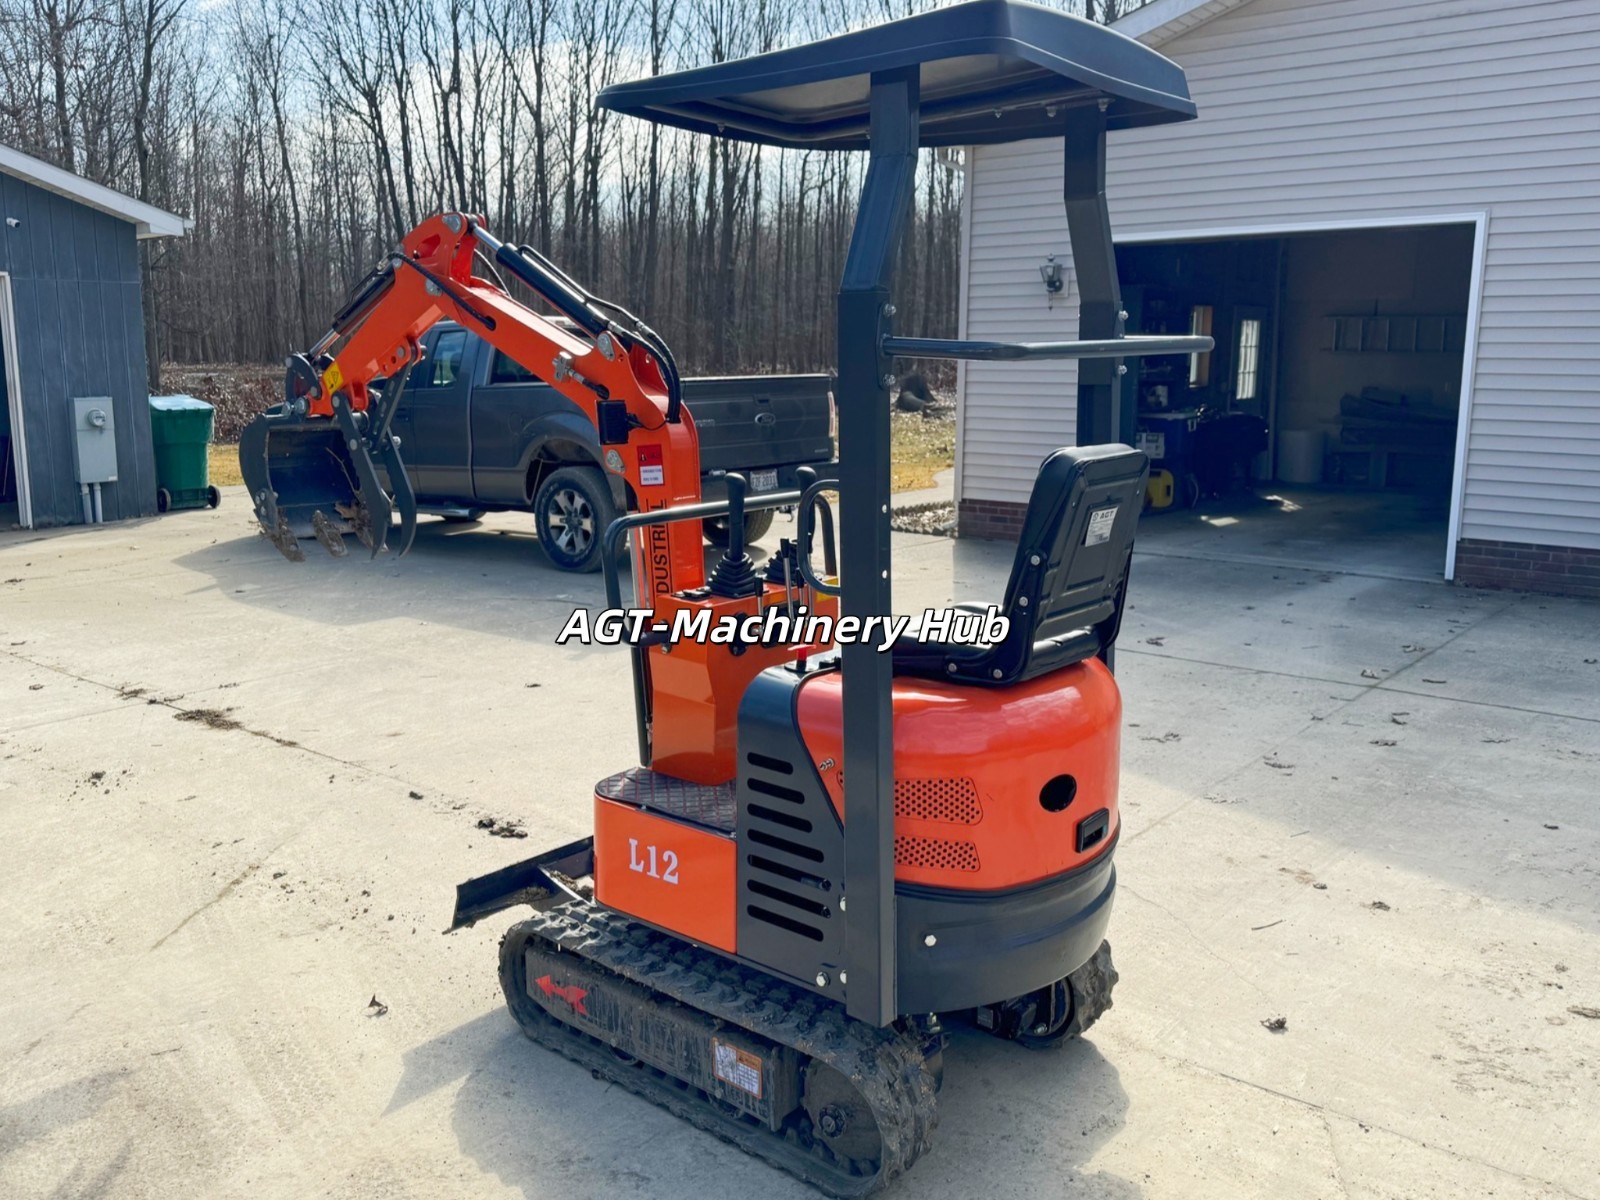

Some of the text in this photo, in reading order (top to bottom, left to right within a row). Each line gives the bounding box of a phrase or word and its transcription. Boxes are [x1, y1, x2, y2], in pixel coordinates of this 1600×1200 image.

[1099, 510, 1115, 520] AGT
[650, 499, 670, 594] DUSTRIL
[629, 838, 679, 885] L12
